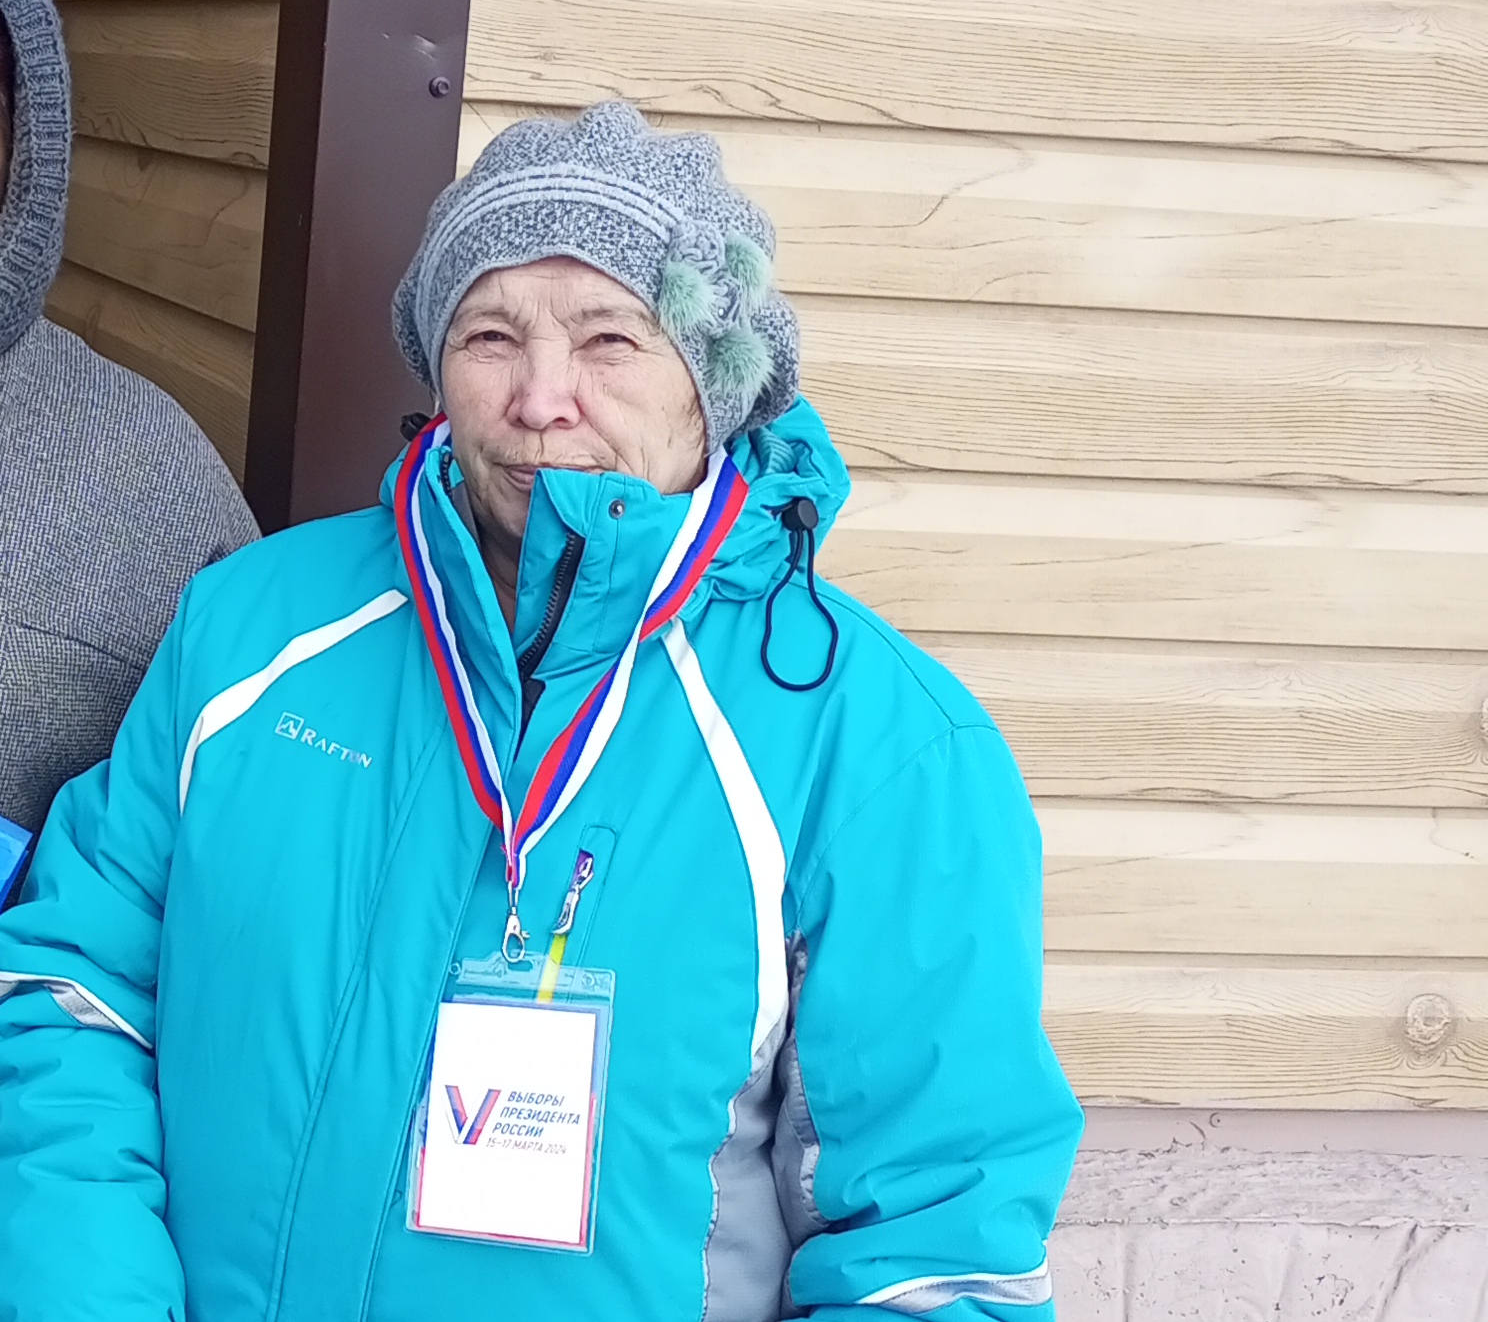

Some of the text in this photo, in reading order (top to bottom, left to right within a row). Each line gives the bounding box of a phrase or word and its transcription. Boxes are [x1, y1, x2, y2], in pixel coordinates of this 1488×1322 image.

[507, 1090, 565, 1107] ВЫБОРЫ
[499, 1106, 581, 1126] ПРЕЗИДЕНТА
[492, 1122, 545, 1139] РОССИИ
[512, 1139, 544, 1153] МАРТА
[544, 1141, 568, 1156] 2024
